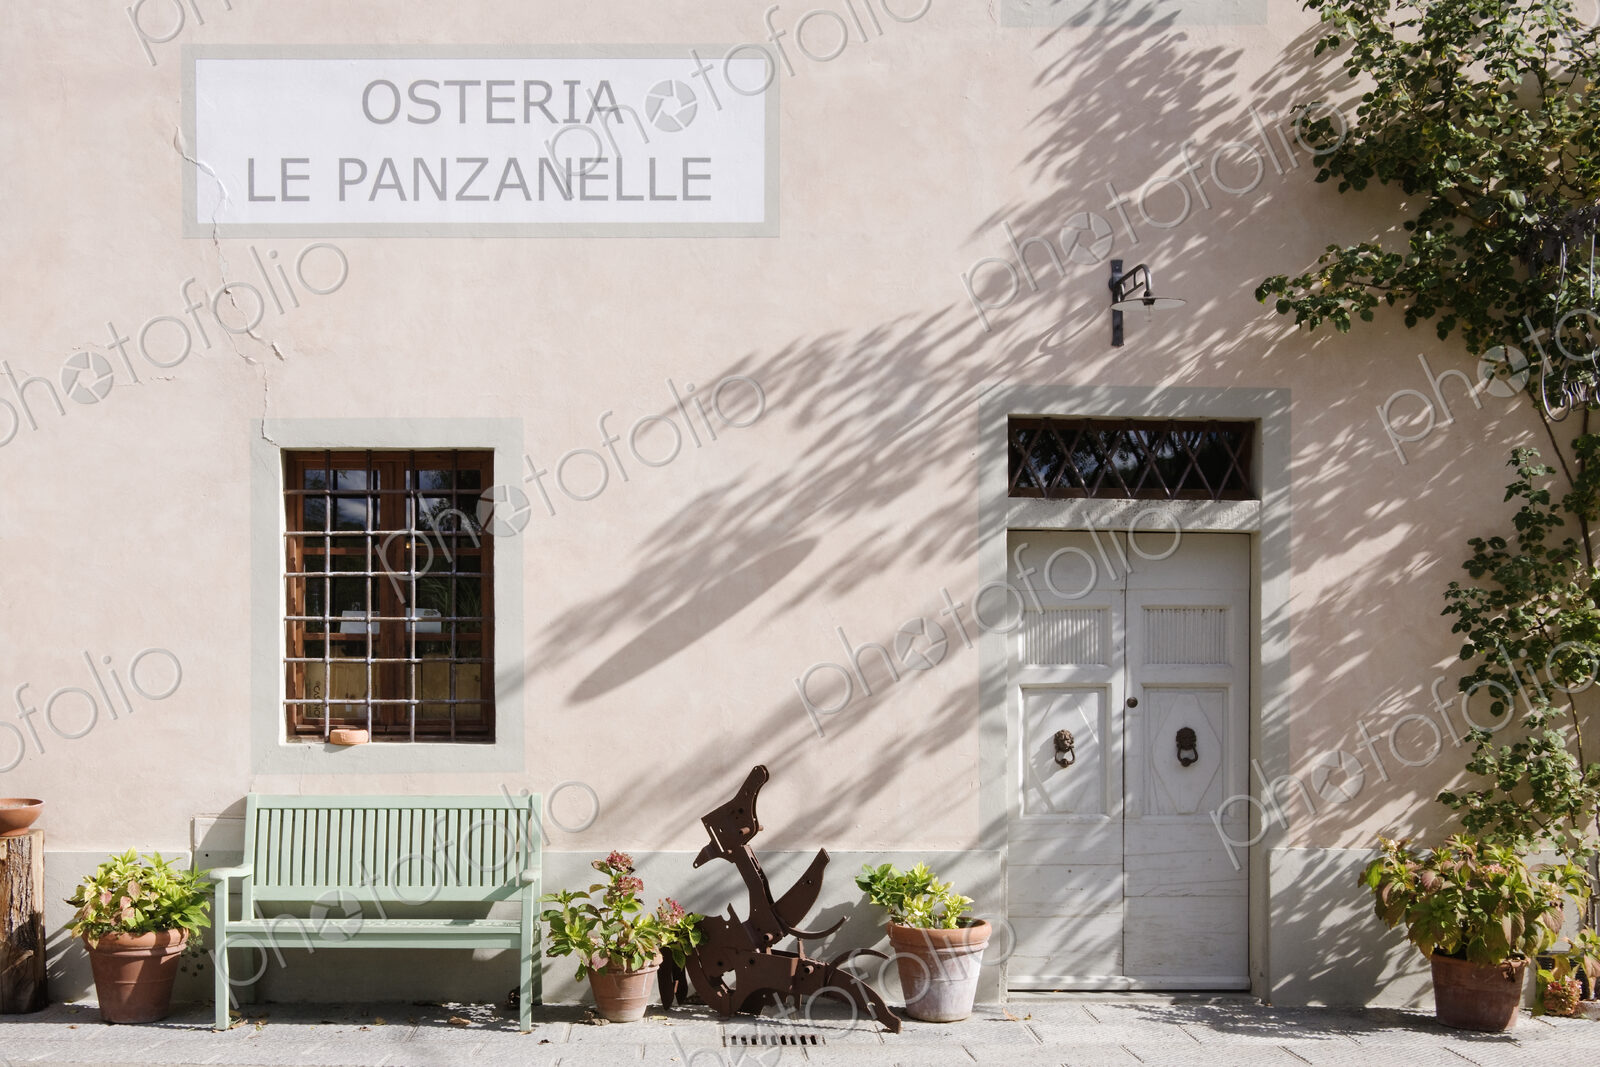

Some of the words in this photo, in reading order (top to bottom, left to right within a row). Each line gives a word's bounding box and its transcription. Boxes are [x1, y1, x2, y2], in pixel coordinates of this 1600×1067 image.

[361, 79, 624, 125] OSTERIA
[247, 157, 310, 202] LE
[338, 157, 712, 202] PANZANELLE
